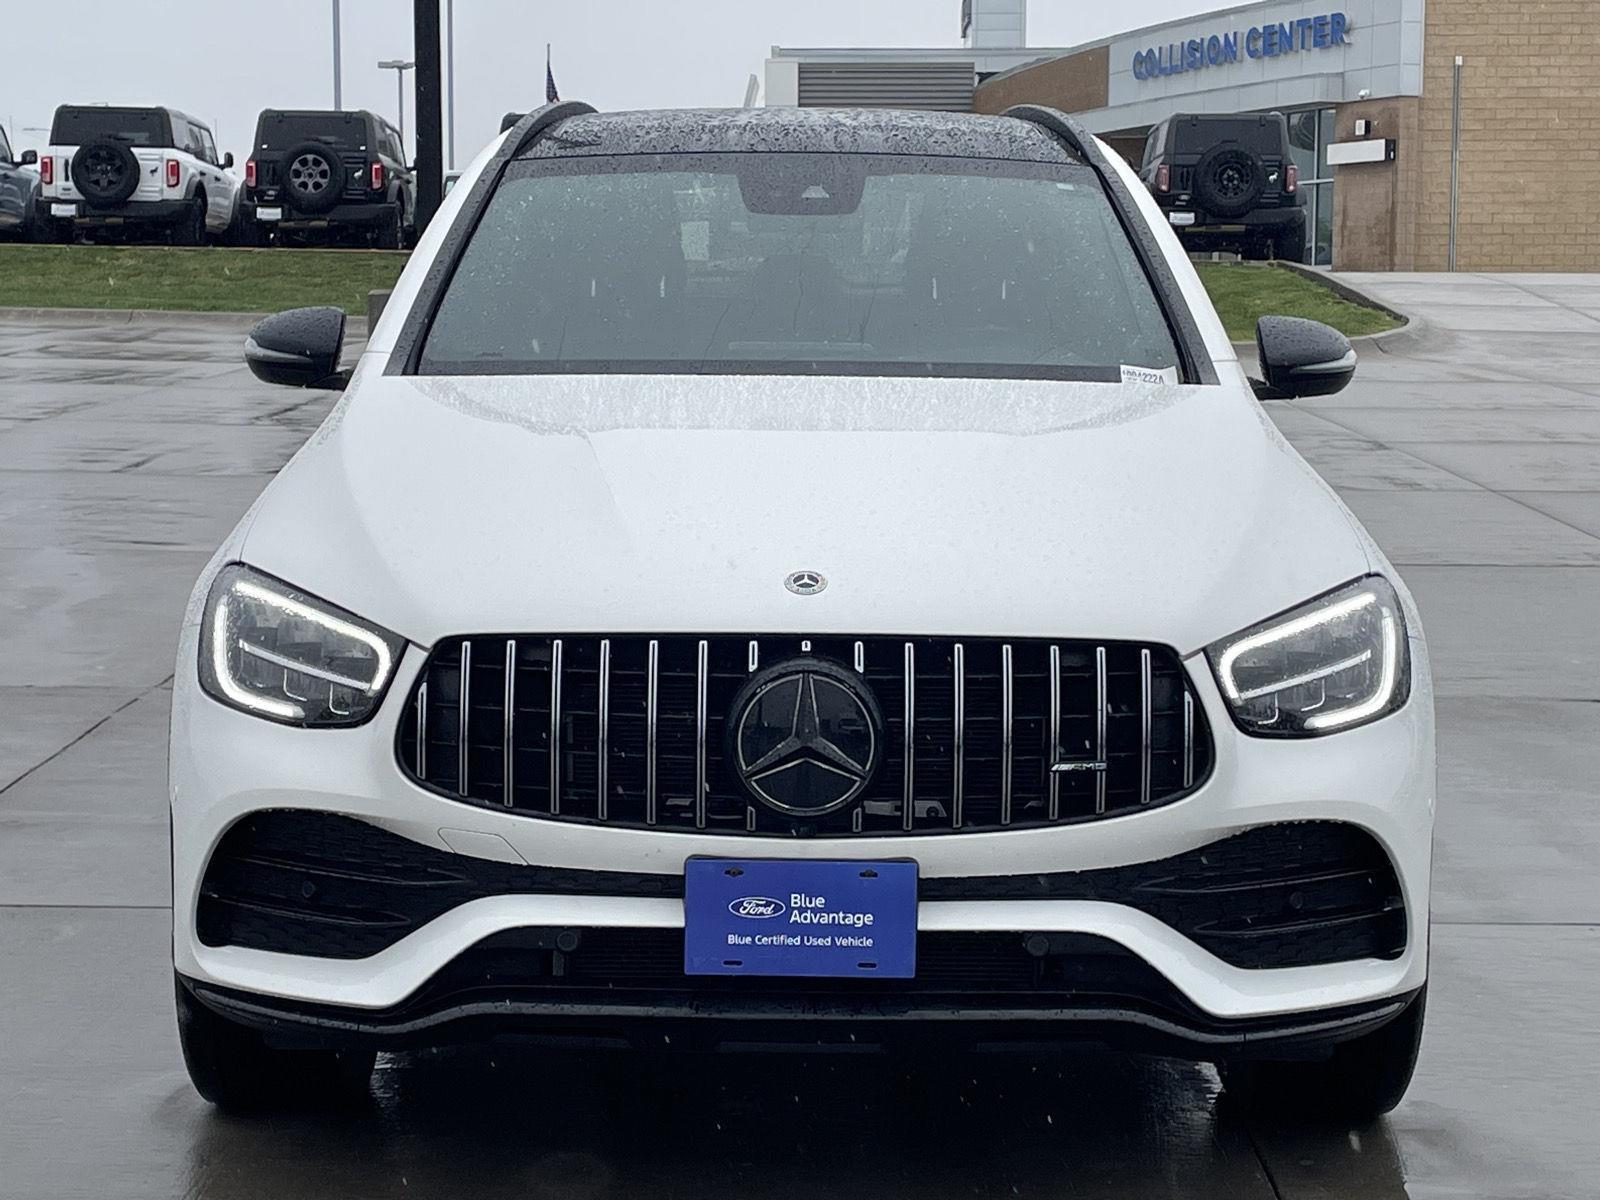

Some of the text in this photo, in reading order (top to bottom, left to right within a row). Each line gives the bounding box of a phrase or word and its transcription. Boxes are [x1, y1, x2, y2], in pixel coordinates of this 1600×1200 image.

[1133, 12, 1350, 80] COLLISION CENTER
[739, 900, 774, 915] Ford
[790, 893, 826, 908] Blue
[789, 910, 874, 928] Advantage
[727, 934, 874, 947] Blue Certified Used Vehicle
